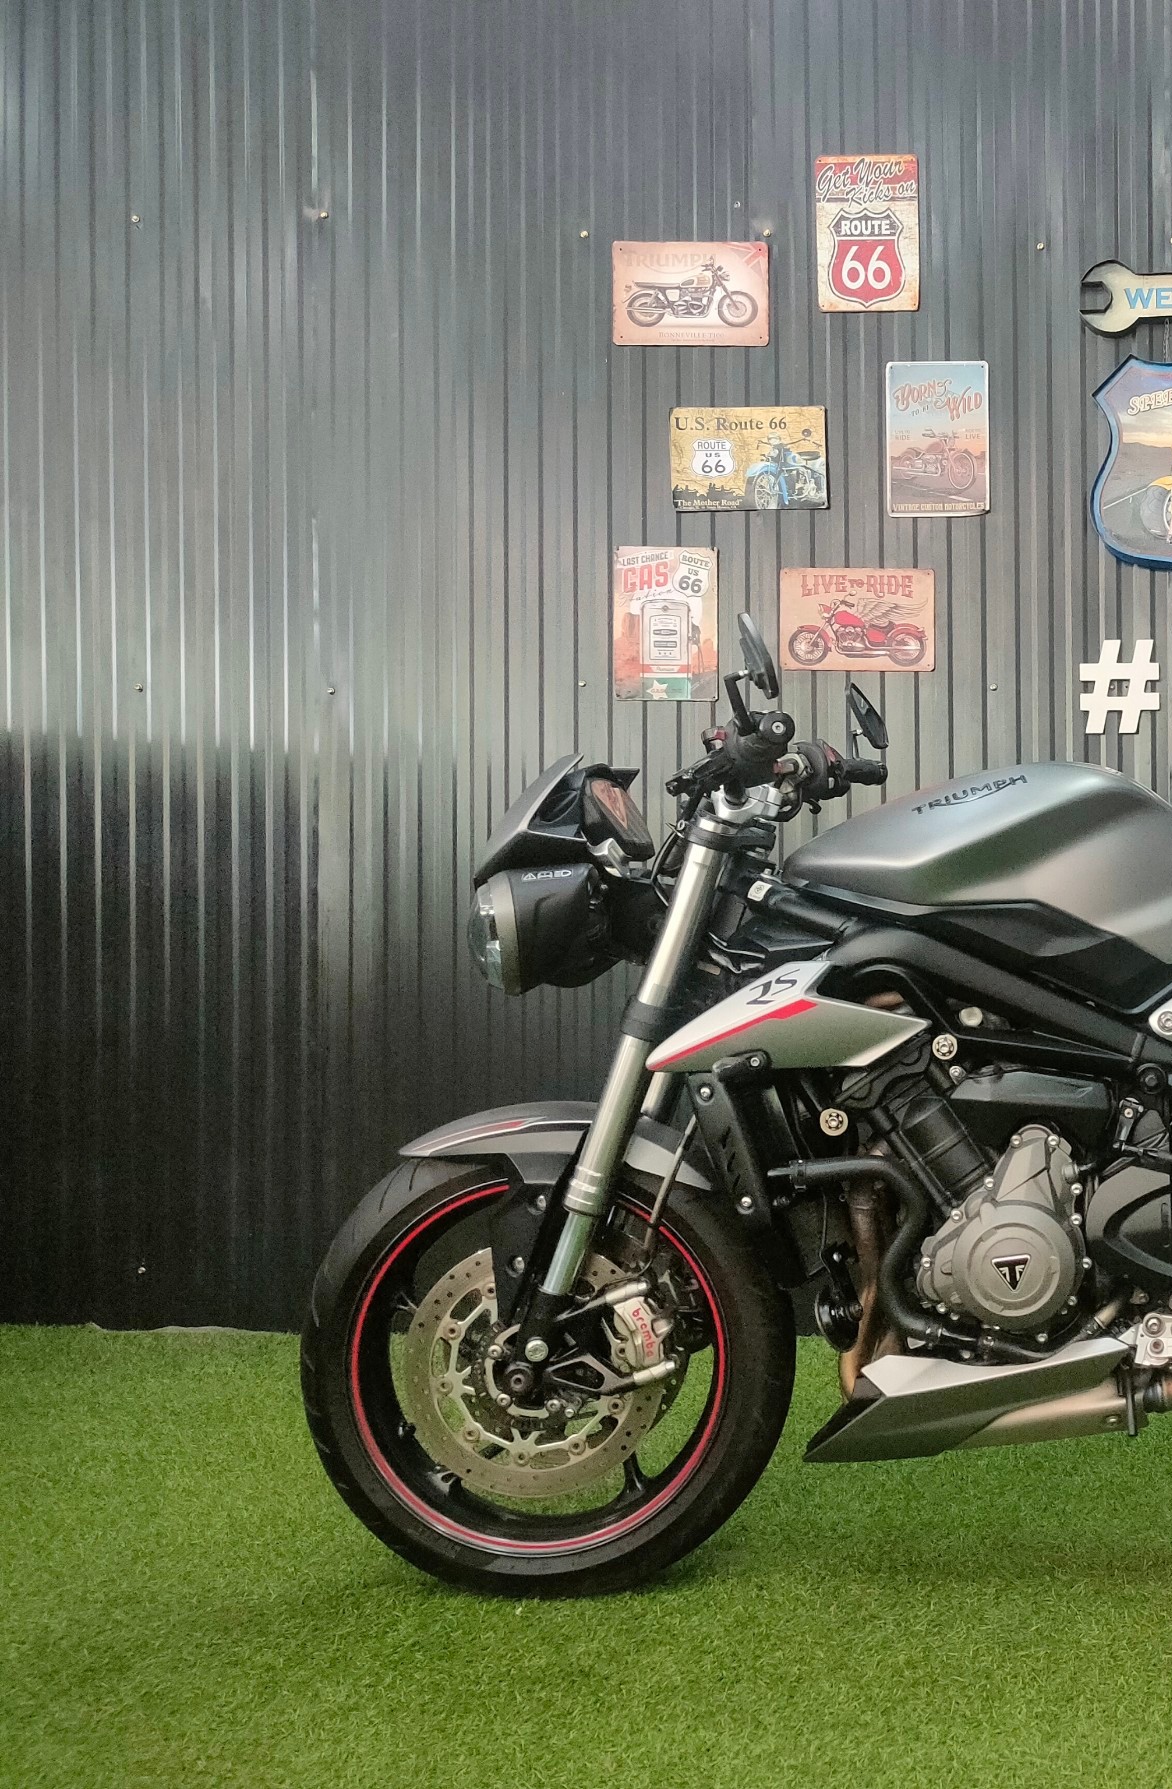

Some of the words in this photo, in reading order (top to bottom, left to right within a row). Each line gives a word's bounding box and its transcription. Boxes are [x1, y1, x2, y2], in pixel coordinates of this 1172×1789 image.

[817, 165, 850, 202] Get
[854, 157, 904, 187] Your
[846, 182, 891, 208] Kicks
[897, 181, 916, 195] on
[840, 220, 891, 235] ROUTE
[624, 252, 717, 268] TRIUMPH
[841, 246, 892, 290] 66
[893, 379, 937, 412] BORN
[938, 386, 982, 421] WILD
[674, 416, 710, 431] U.S.
[716, 416, 764, 431] Route
[769, 416, 787, 430] 66
[697, 441, 726, 450] ROUTE
[701, 459, 726, 474] 66
[622, 556, 639, 567] LAST
[640, 551, 669, 564] CHANCE
[682, 554, 710, 568] ROUTE
[623, 560, 669, 594] GAS
[688, 567, 699, 577] US
[678, 575, 703, 594] 66
[801, 574, 848, 598] LIVE
[866, 574, 913, 598] RIDE
[619, 589, 676, 607] Station
[911, 774, 1028, 815] TRIUMPH
